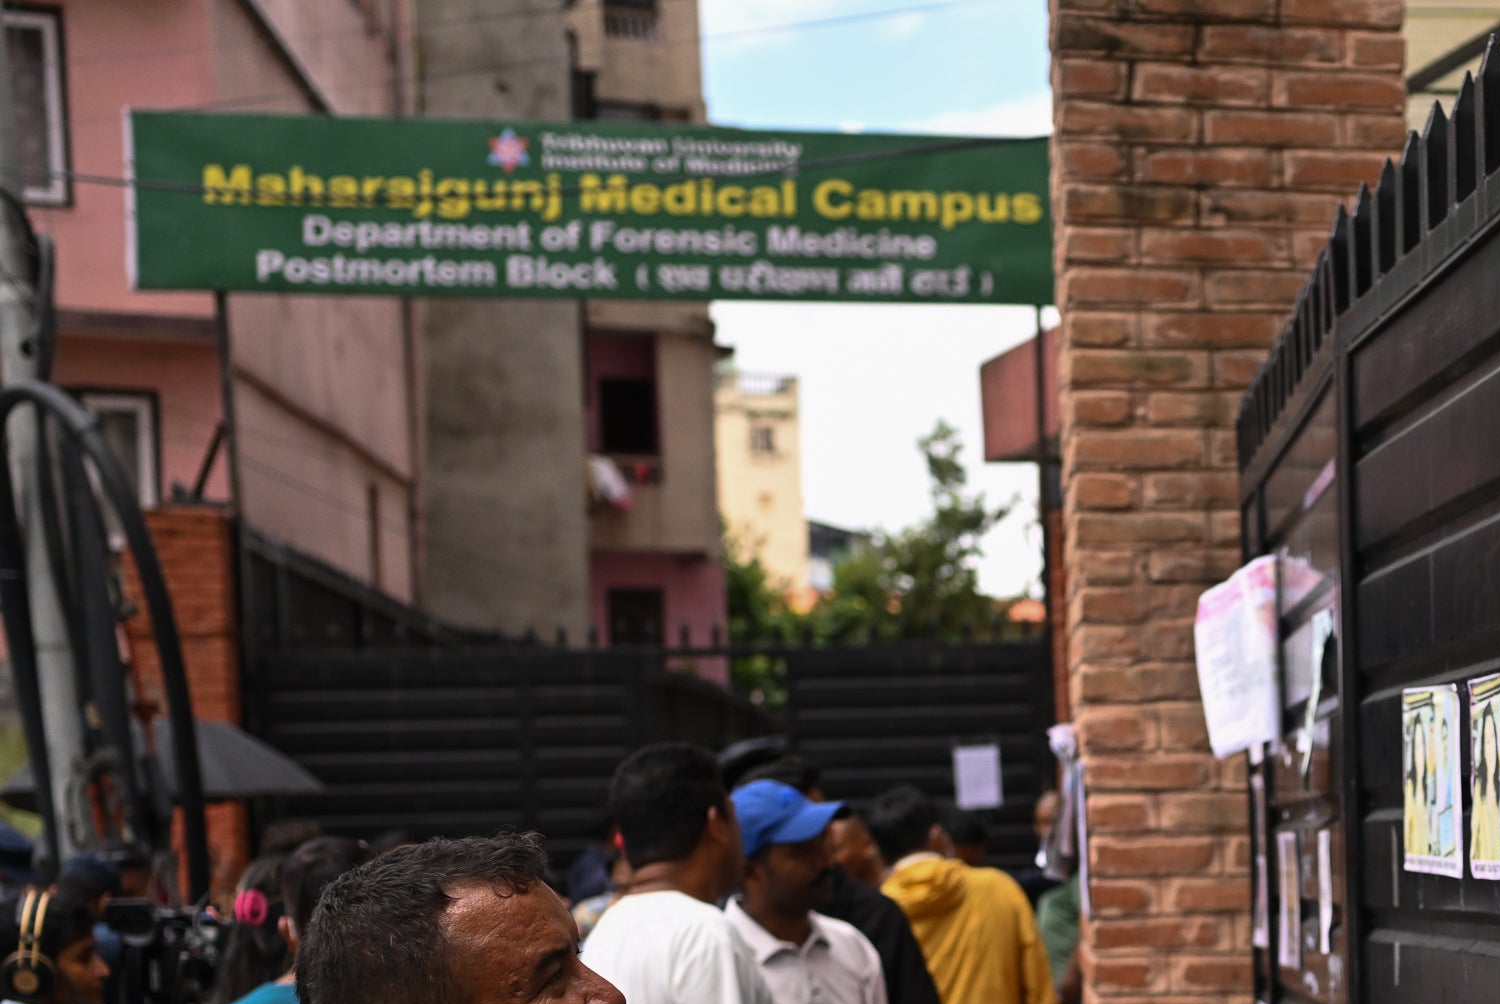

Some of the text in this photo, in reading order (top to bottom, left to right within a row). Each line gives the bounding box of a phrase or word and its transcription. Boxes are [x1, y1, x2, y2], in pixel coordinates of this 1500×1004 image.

[541, 151, 800, 176] Institute of Medicine
[671, 135, 802, 159] University
[203, 163, 1043, 230] Maharajgunj Medical Campus
[302, 214, 937, 260] Department of Forensic Medicine
[256, 249, 497, 286] Postmortem
[507, 254, 619, 289] Block
